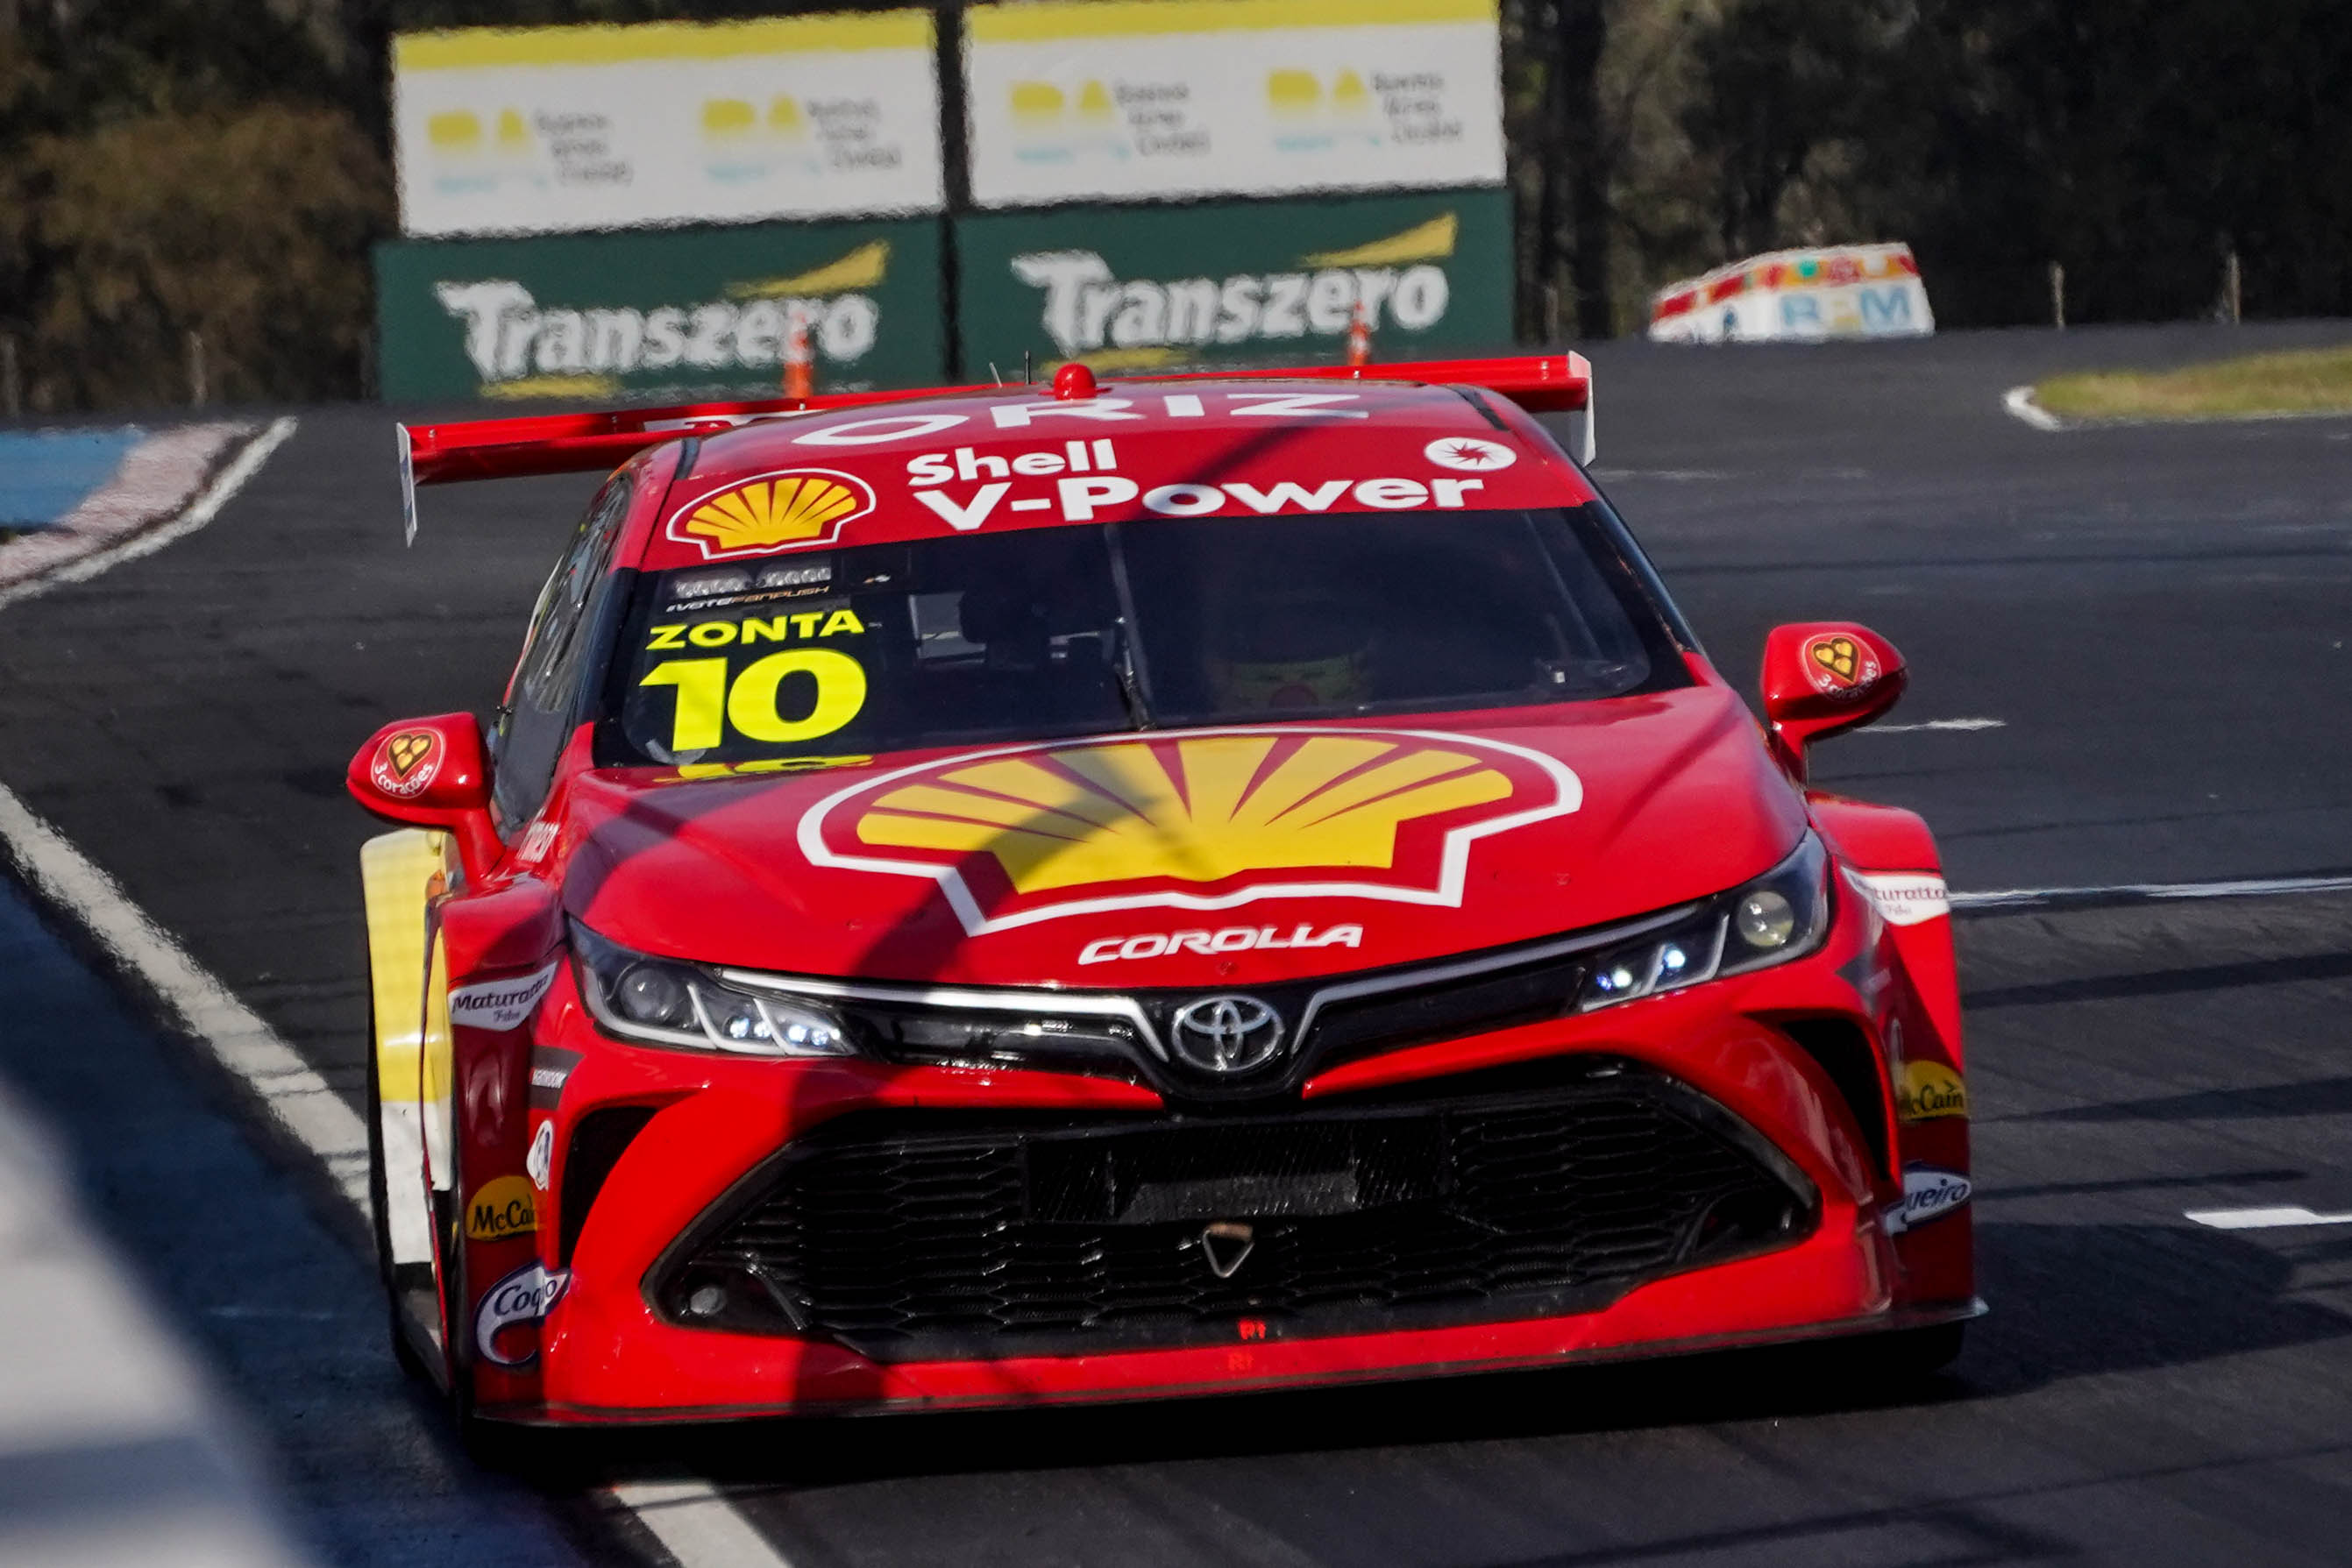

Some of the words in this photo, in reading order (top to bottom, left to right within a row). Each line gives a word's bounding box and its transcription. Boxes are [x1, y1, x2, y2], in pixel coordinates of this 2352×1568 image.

[1012, 249, 1449, 357] Transzero
[435, 280, 878, 382] Transzero
[907, 438, 1117, 486] Shell
[913, 476, 1483, 530] V-Power
[645, 610, 864, 649] ZONTA
[639, 649, 866, 751] 10
[1077, 924, 1363, 965] COROLLA
